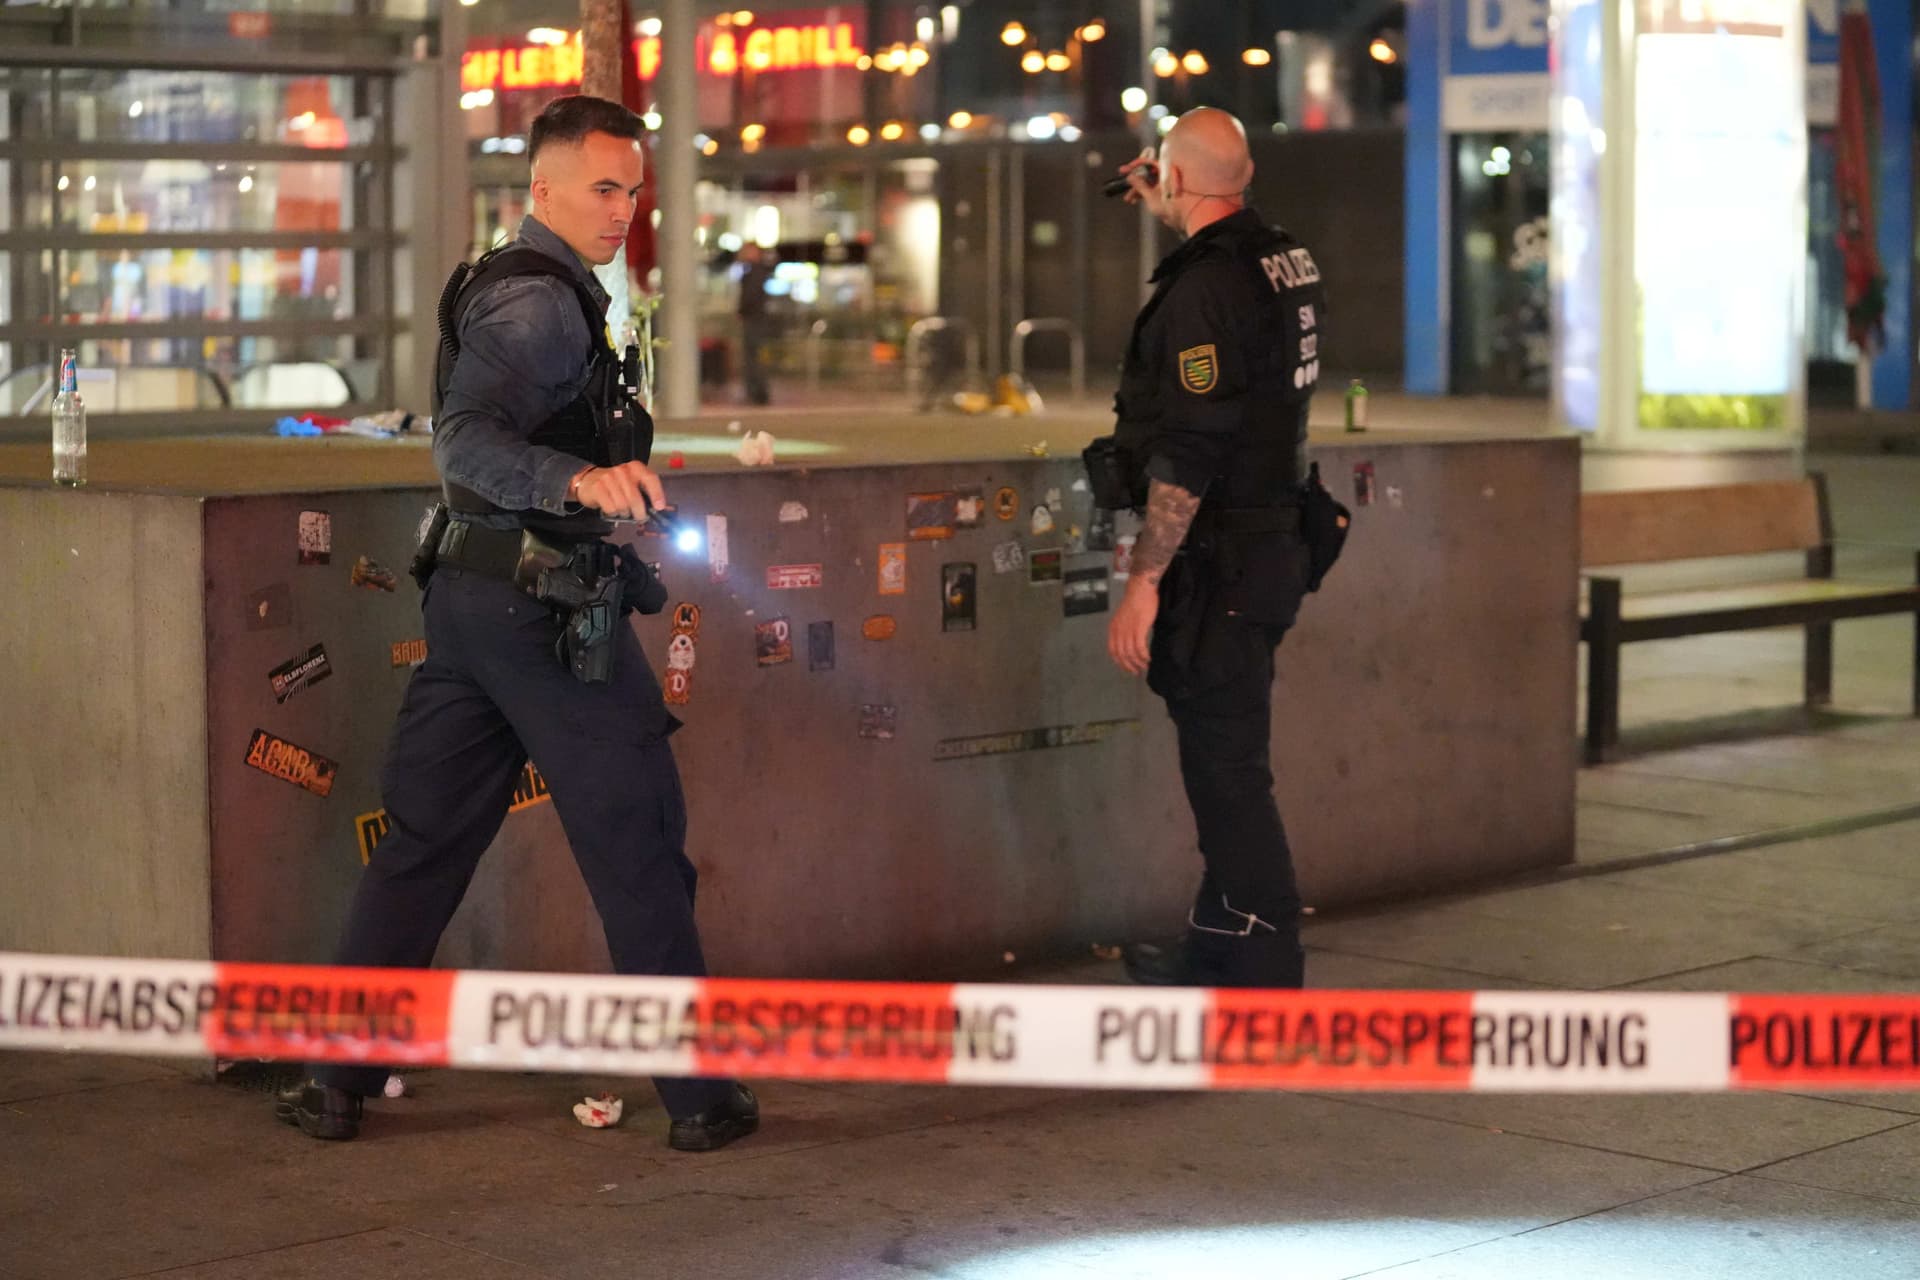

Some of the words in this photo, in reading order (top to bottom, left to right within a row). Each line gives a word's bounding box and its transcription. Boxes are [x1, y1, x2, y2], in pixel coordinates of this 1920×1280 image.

[743, 25, 861, 70] GRILL
[283, 653, 326, 683] ELBFLORENZ
[489, 989, 1016, 1061] POLIZEIABSPERRUNG
[1095, 1008, 1648, 1069] POLIZEIABSPERRUNG
[1729, 1012, 1920, 1070] POLIZEI
